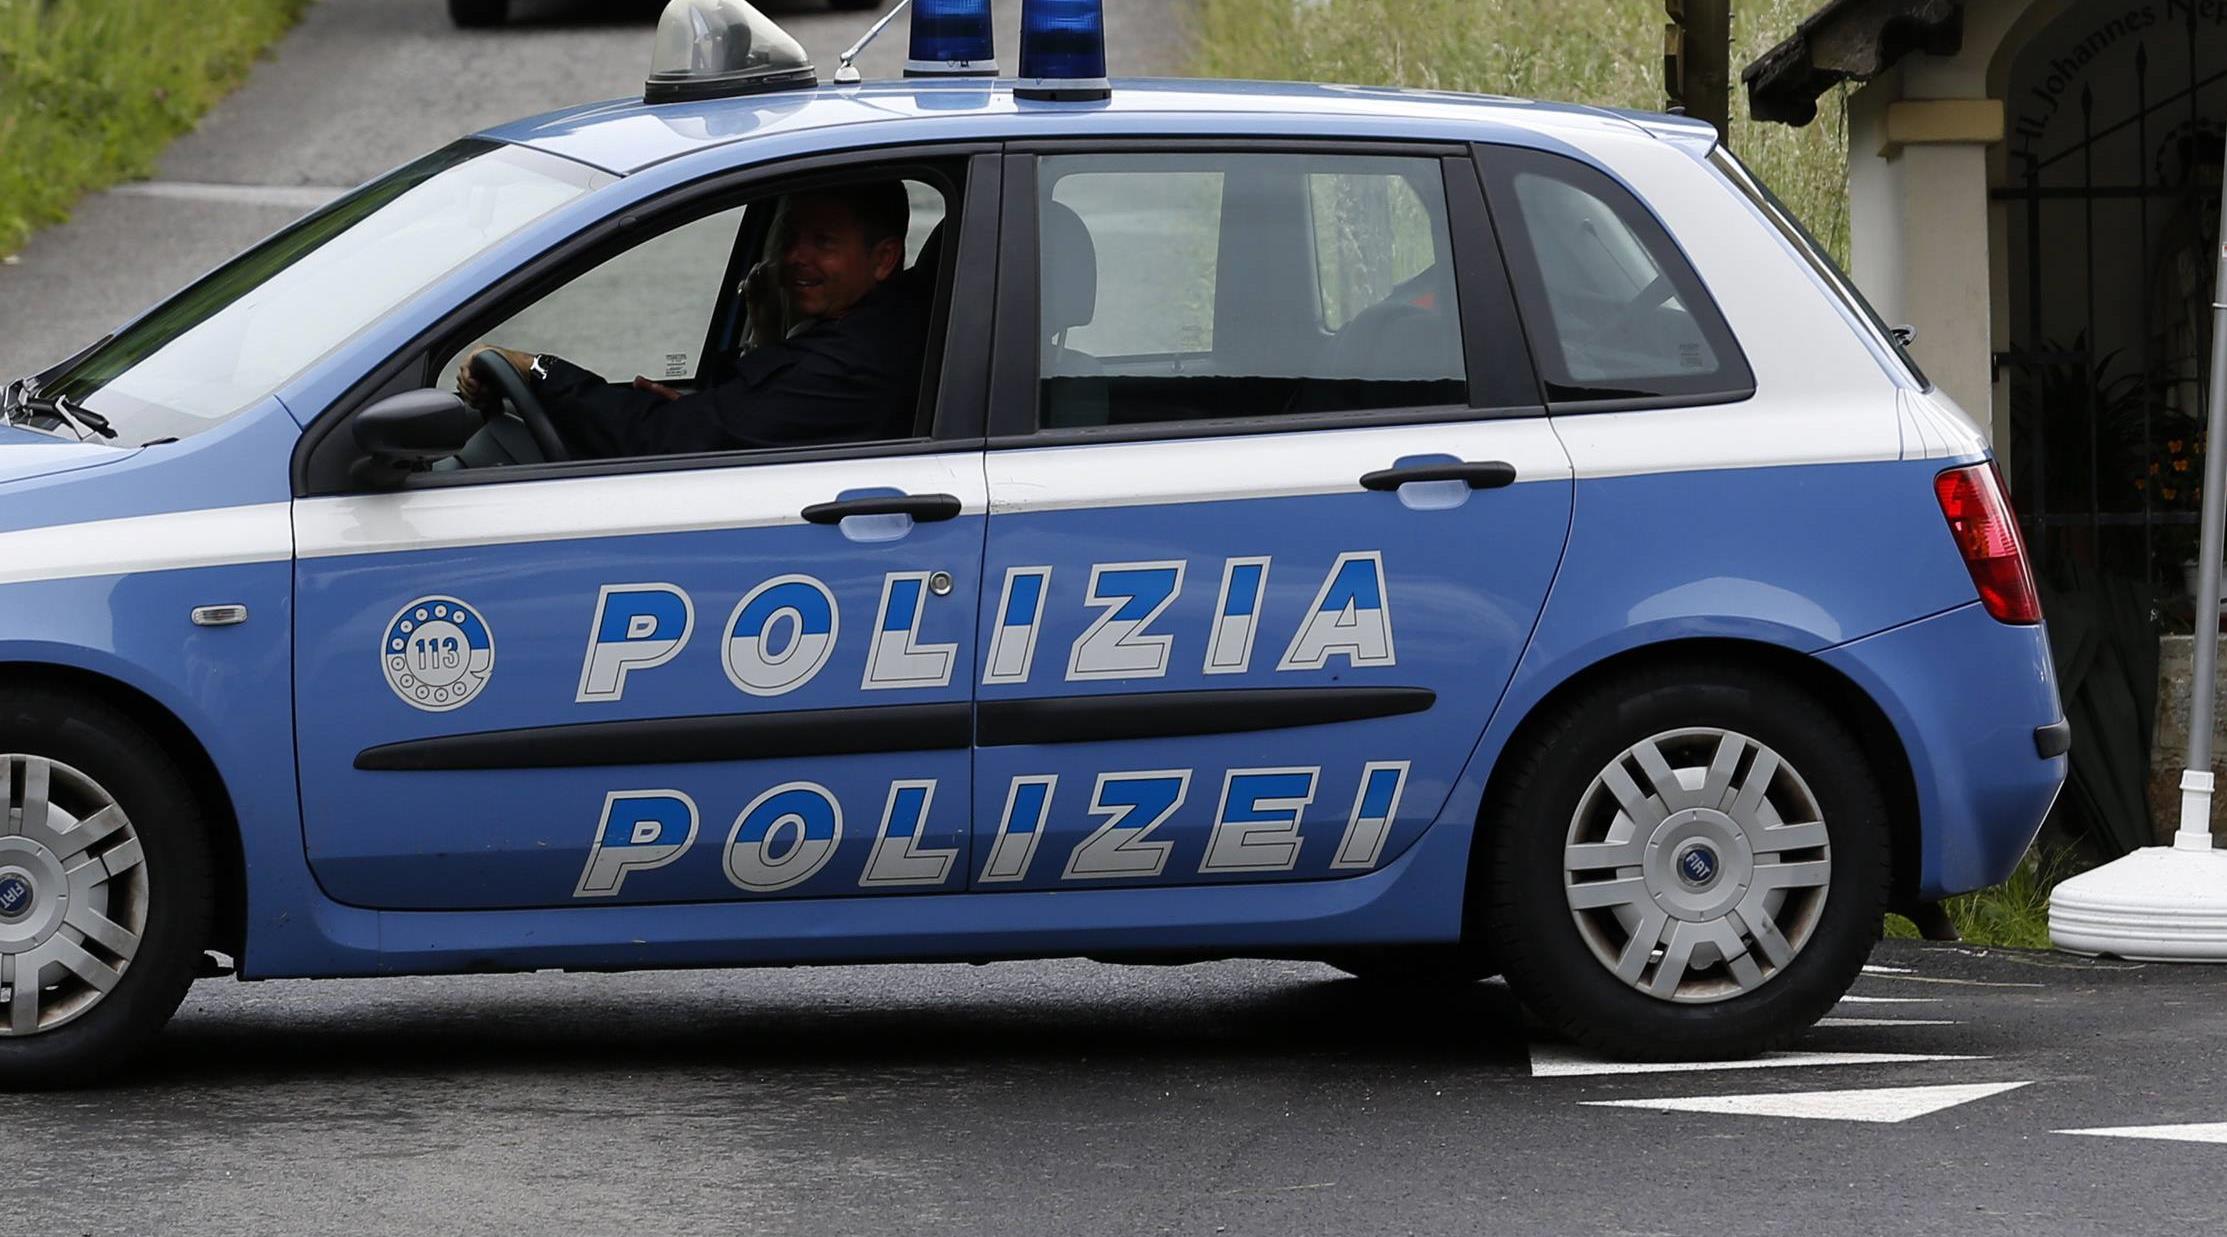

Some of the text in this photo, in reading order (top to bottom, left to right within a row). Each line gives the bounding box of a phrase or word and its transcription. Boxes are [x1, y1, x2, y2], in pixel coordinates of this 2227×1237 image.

[2032, 5, 2155, 113] Johannes
[415, 636, 460, 670] 113
[575, 550, 1396, 703] POLIZIA
[573, 760, 1410, 898] POLIZEI
[1686, 852, 1710, 877] FIAT
[0, 882, 25, 909] FIAT
